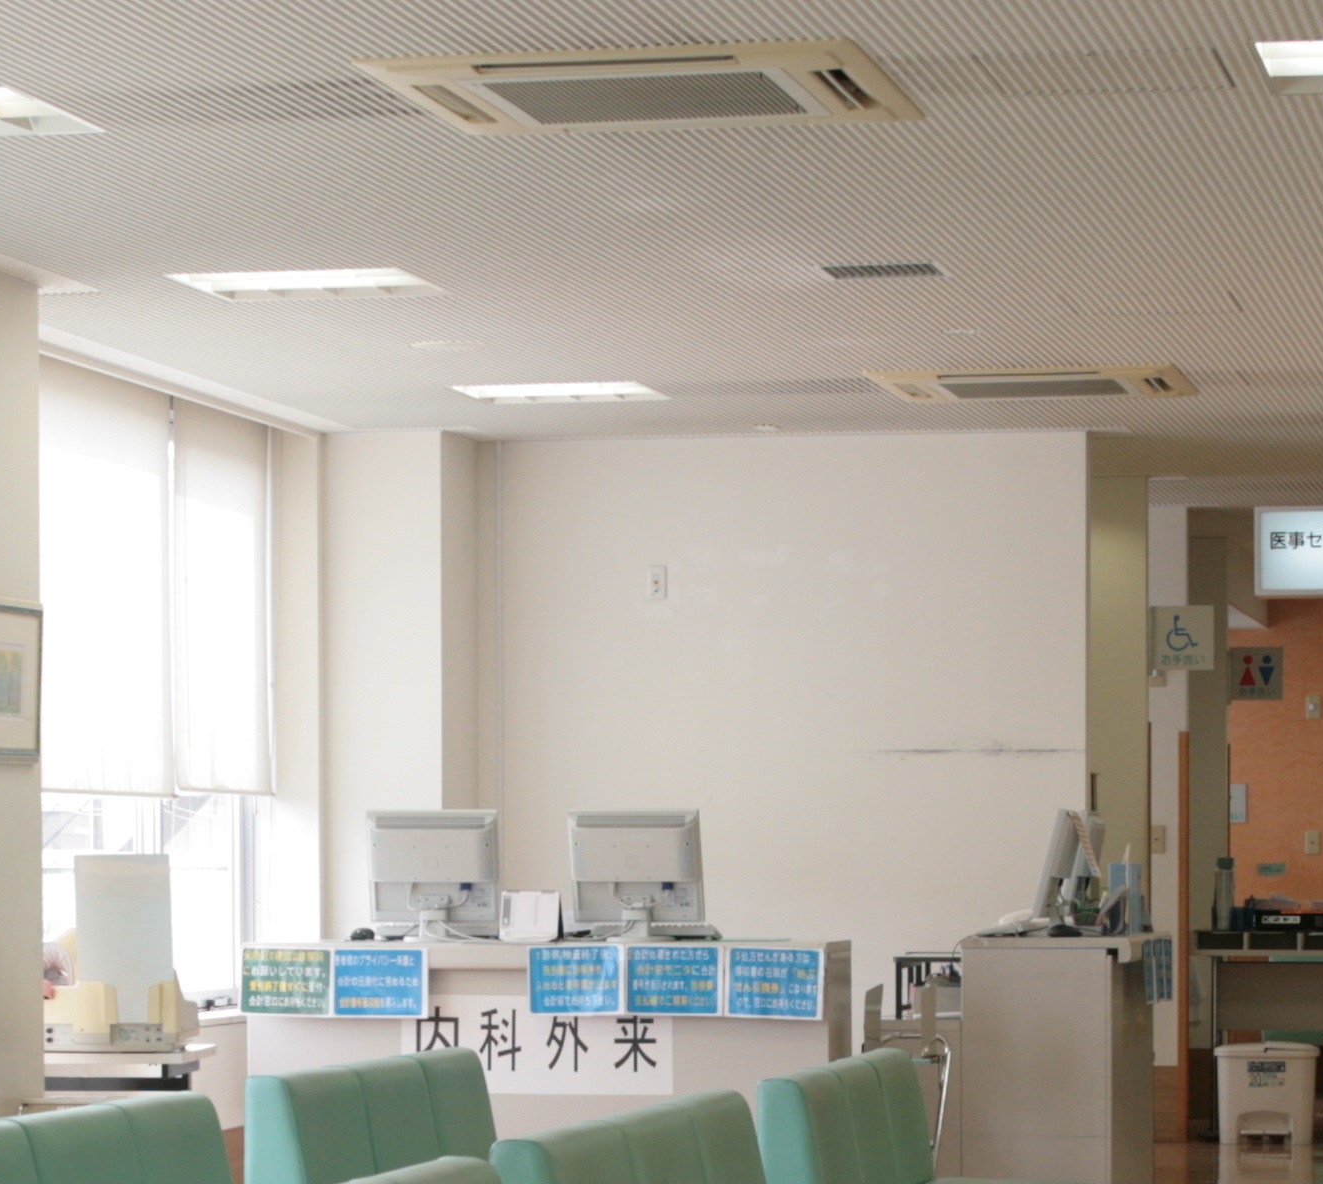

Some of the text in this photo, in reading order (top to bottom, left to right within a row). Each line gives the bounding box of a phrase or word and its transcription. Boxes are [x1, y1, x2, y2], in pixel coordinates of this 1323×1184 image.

[1161, 654, 1205, 666] お手洗い
[415, 1005, 658, 1073] 内科外来
